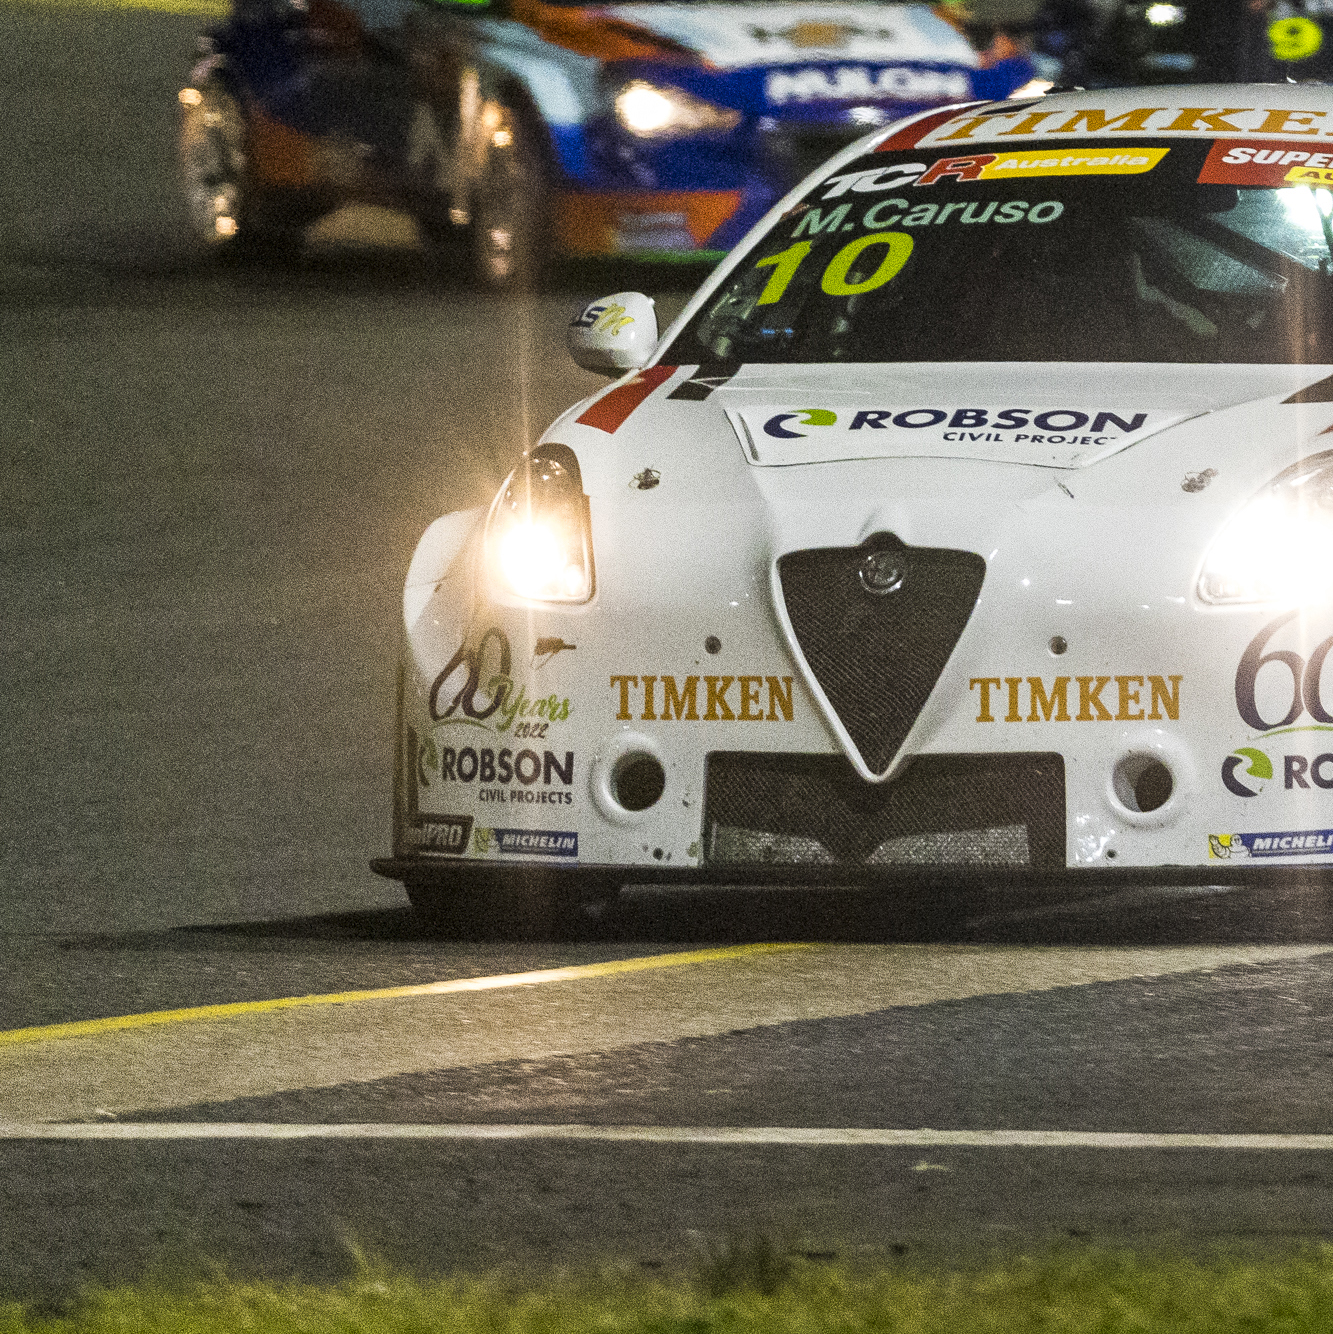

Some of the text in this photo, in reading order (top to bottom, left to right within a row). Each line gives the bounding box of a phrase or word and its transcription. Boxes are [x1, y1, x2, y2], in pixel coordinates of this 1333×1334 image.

[1267, 17, 1323, 61] 9
[821, 152, 1150, 200] TCR Australia
[791, 198, 1065, 239] M.Caruso
[756, 231, 915, 306] 10
[848, 408, 1148, 433] ROBSON
[943, 432, 1003, 443] CIVIL
[488, 673, 570, 733] Years
[610, 675, 794, 722] TIMKEN
[969, 675, 1183, 723] TIMKEN
[514, 723, 550, 740] 2022
[442, 746, 574, 786] ROBSON
[478, 789, 573, 805] CIVIL PROJECTS
[502, 833, 576, 849] MICHELIN
